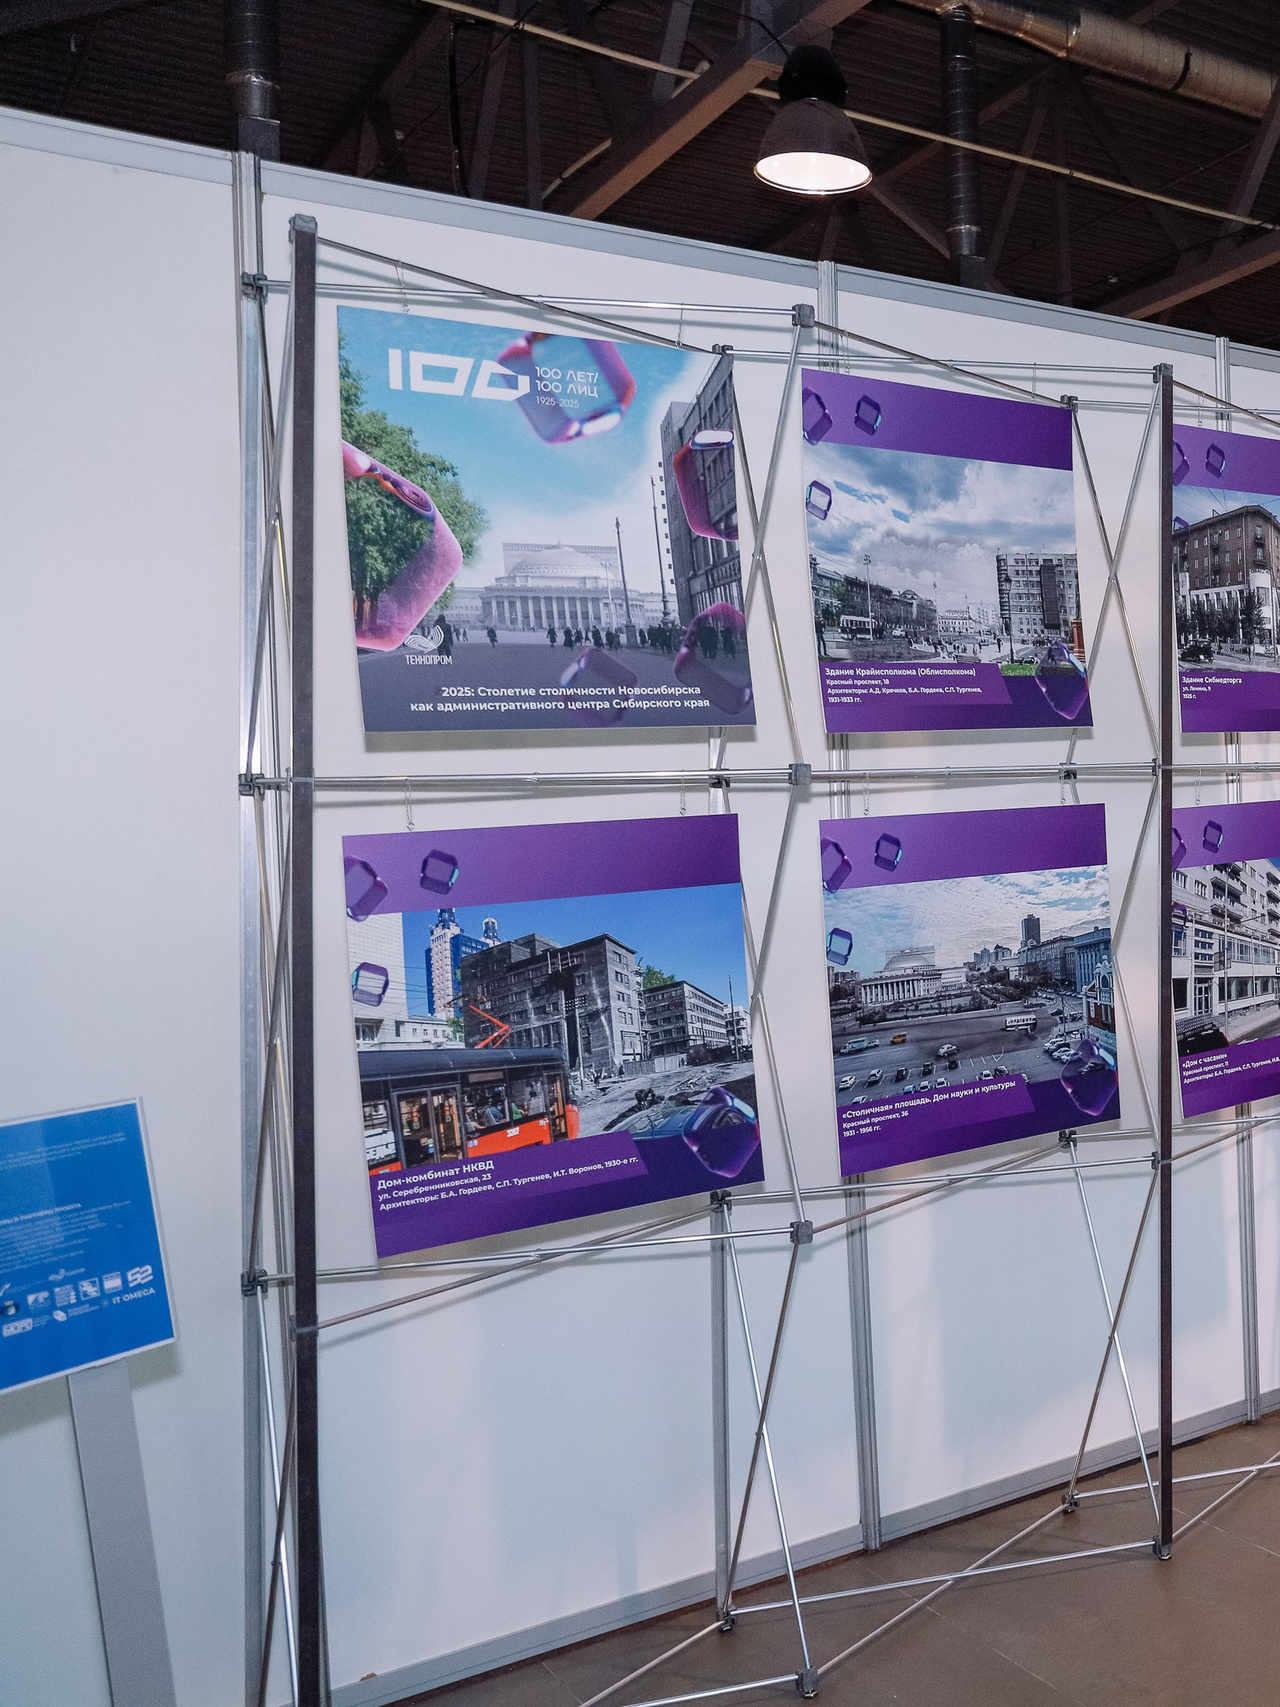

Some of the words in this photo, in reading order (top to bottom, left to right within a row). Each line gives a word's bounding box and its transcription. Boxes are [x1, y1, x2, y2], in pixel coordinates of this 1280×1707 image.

[535, 366, 561, 379] 100
[566, 370, 599, 383] ЛЕТ/
[535, 379, 562, 392] 100
[566, 382, 599, 398] ЛИЦ
[405, 654, 453, 665] ТЕХНОПРОМ
[825, 667, 854, 676] Здание
[855, 667, 916, 677] Крайисполкома
[917, 667, 976, 677] (Облисполкома)
[1182, 676, 1203, 684] Здание
[441, 687, 475, 697] 2025:
[477, 686, 536, 697] Столетие
[539, 686, 615, 696] столичности
[618, 684, 701, 697] Новосибирска
[410, 702, 434, 711] как
[436, 700, 565, 712] административного
[568, 700, 610, 711] центра
[612, 698, 682, 710] Сибирского
[684, 699, 710, 709] края
[842, 1104, 893, 1119] «Столичная»
[933, 1093, 949, 1102] Дом
[950, 1087, 973, 1098] науки
[981, 1080, 1016, 1093] культуры
[842, 1118, 870, 1129] Красный
[377, 1167, 460, 1191] Дом-комбинат
[462, 1160, 494, 1174] НКВД
[378, 1193, 391, 1202] ул.
[392, 1175, 481, 1198] Серебренниковская,
[482, 1173, 492, 1181] 23
[379, 1194, 439, 1211] Архитекторы:
[440, 1191, 457, 1199] Б.А.
[459, 1184, 495, 1196] Гордеев,
[496, 1178, 512, 1189] С.П.
[513, 1173, 552, 1185] Тургенев,
[553, 1169, 567, 1178] И.Т.
[569, 1163, 604, 1175] Воронов,
[604, 1158, 628, 1168] 1930-е
[112, 1296, 121, 1305] IT
[122, 1287, 156, 1302] OMEGA
